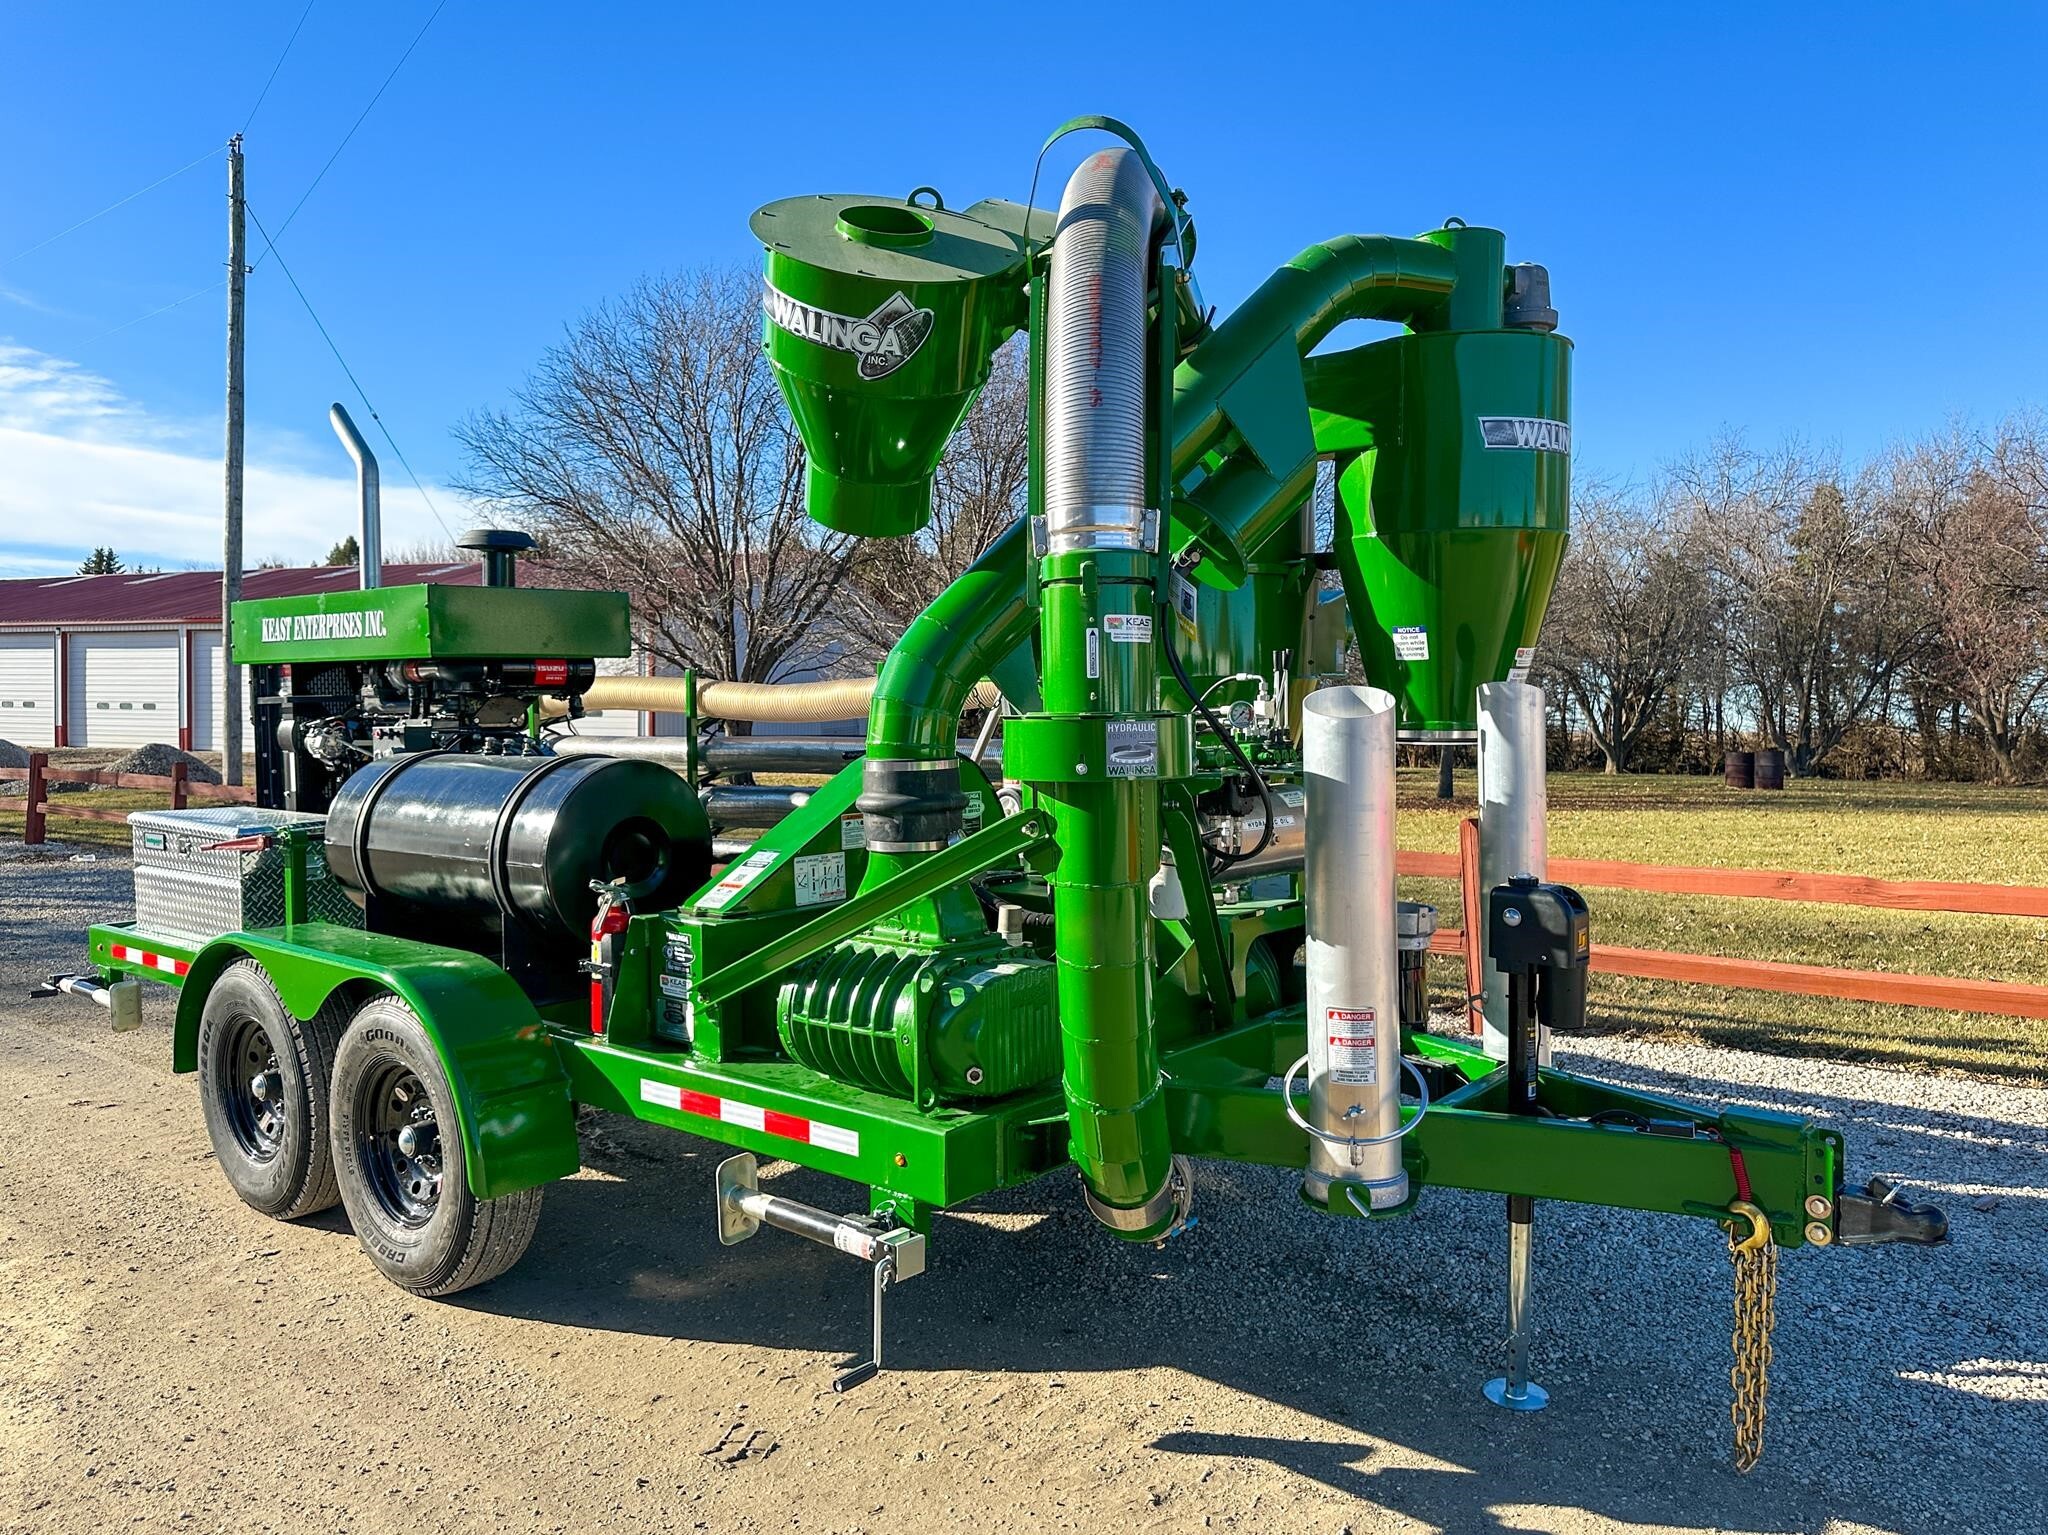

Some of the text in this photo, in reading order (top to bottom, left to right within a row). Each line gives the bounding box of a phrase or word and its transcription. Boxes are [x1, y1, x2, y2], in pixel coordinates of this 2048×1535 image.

[773, 291, 901, 356] WALINGA
[867, 355, 889, 367] INC.
[262, 610, 387, 642] KEAST ENTERPRISES INC.
[1107, 723, 1156, 732] HYDRAULIC
[1107, 765, 1156, 776] WALINGA
